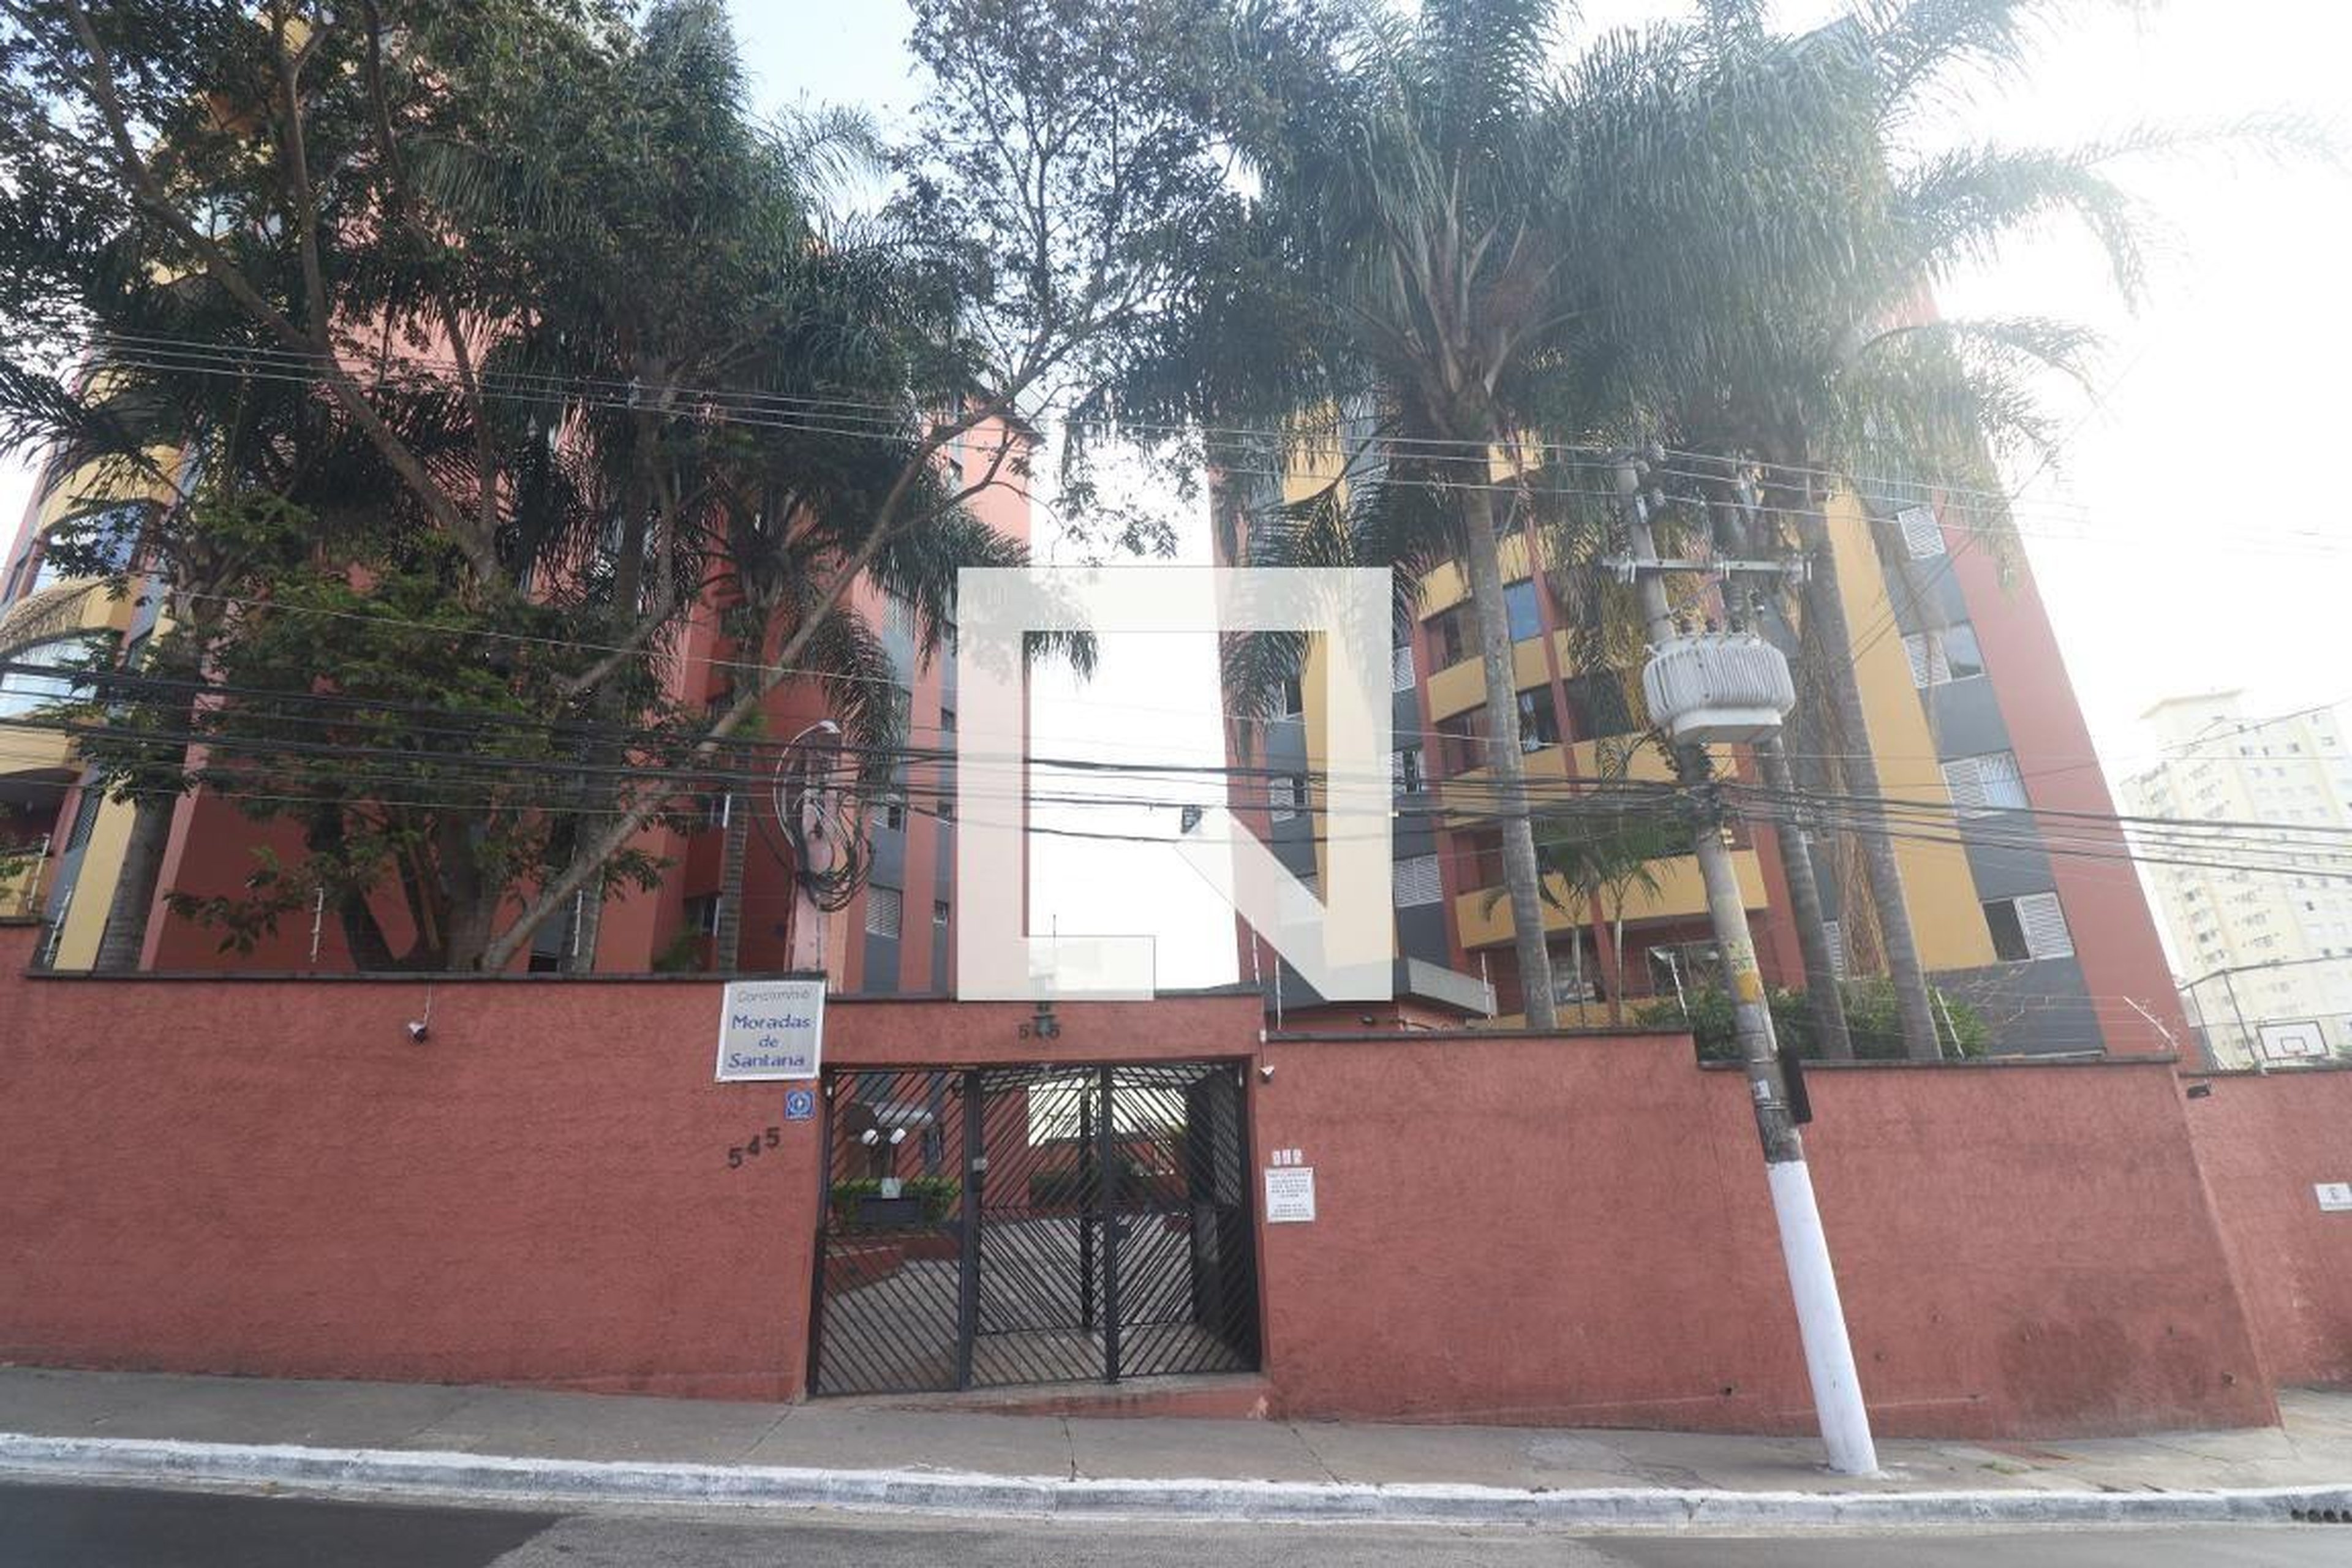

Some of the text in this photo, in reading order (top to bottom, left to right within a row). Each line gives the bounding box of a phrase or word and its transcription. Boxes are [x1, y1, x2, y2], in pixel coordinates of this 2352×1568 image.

[732, 1014, 810, 1030] Moradas
[1018, 1023, 1060, 1039] 55
[759, 1035, 778, 1047] de
[728, 1053, 805, 1068] Santana
[729, 1127, 780, 1168] 545
